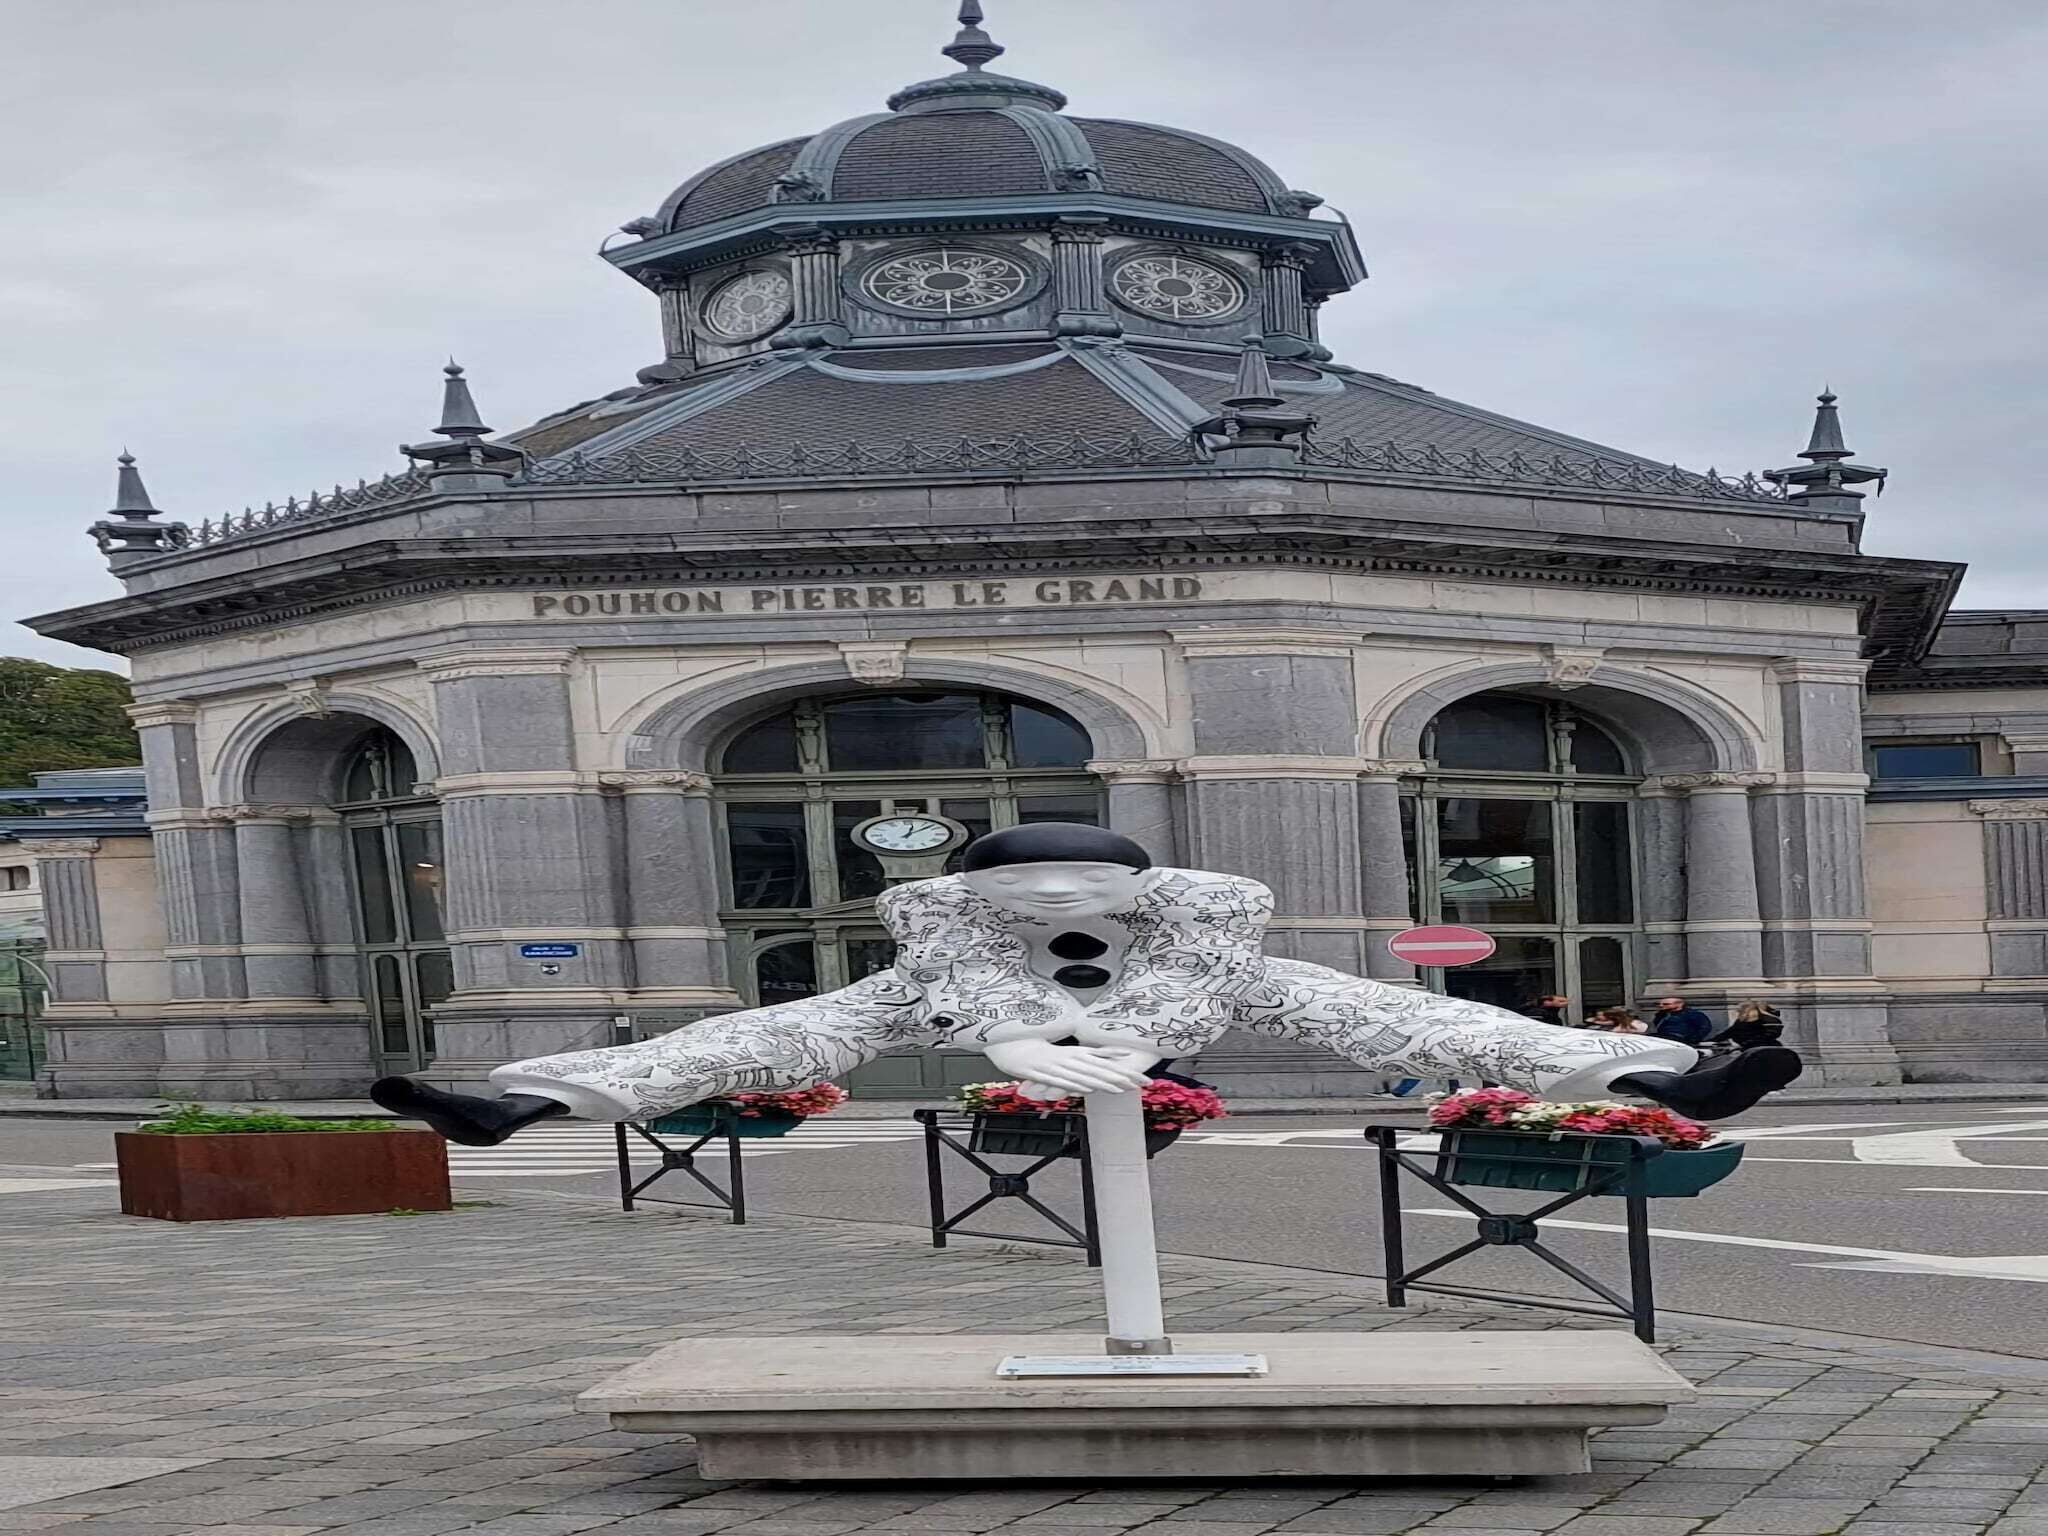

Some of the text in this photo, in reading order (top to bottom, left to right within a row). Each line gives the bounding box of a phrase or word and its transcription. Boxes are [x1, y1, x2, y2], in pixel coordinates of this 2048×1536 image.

[533, 577, 1203, 616] POUHON PIERRE LE GRAND
